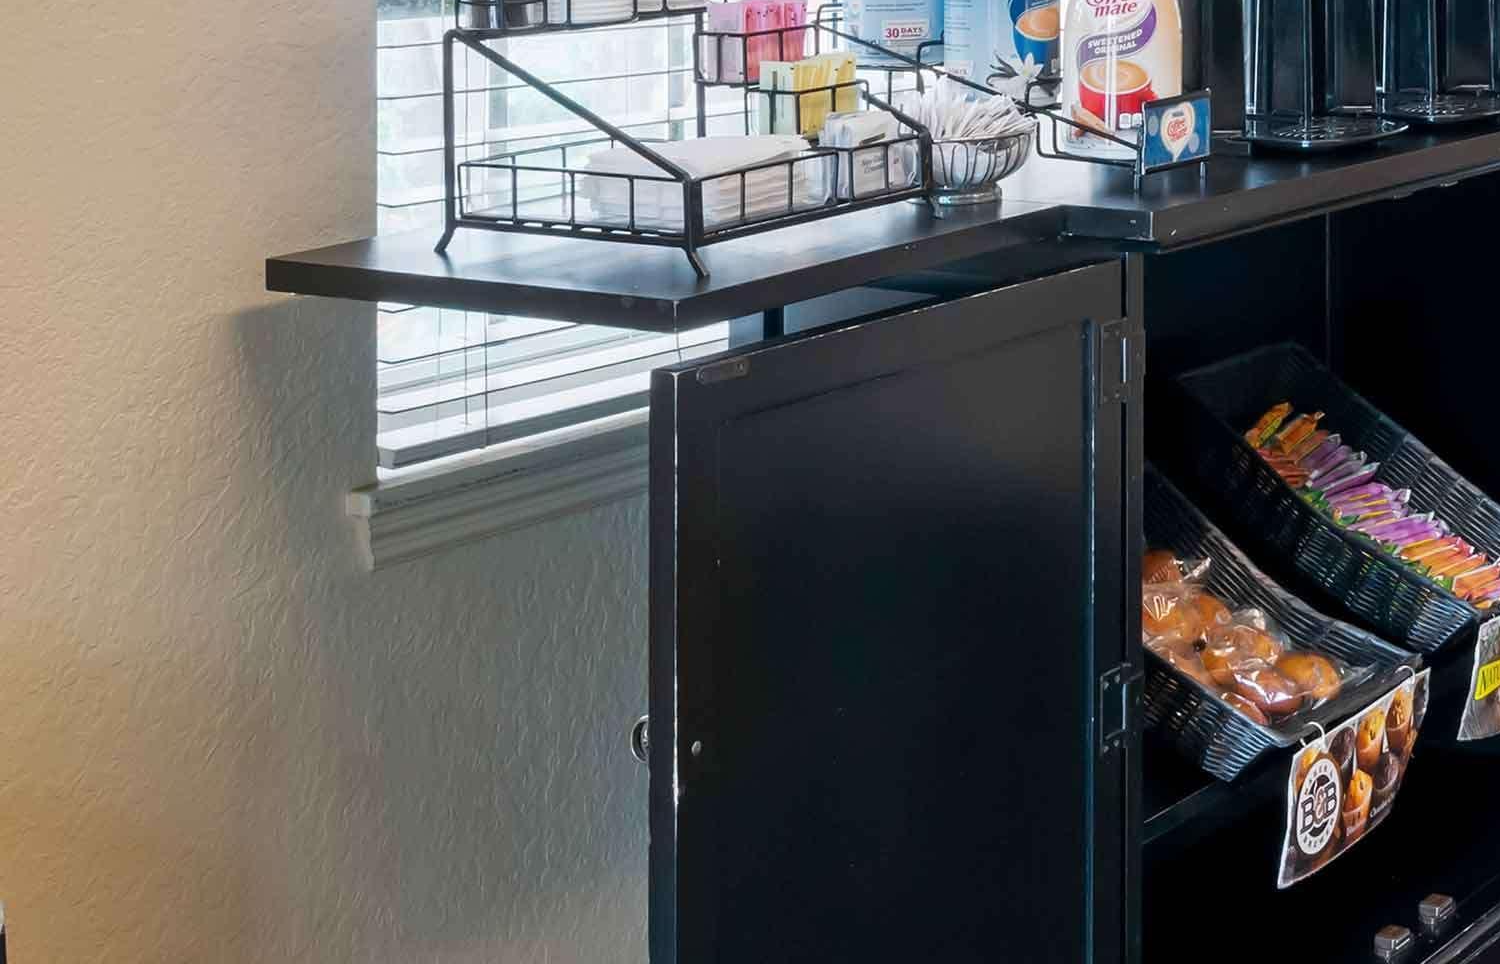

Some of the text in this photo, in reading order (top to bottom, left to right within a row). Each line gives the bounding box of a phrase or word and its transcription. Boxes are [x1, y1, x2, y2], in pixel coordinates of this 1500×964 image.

[1094, 1, 1138, 18] mate
[885, 27, 900, 39] 30
[1094, 40, 1137, 54] ORNAL
[1300, 780, 1338, 836] B&B
